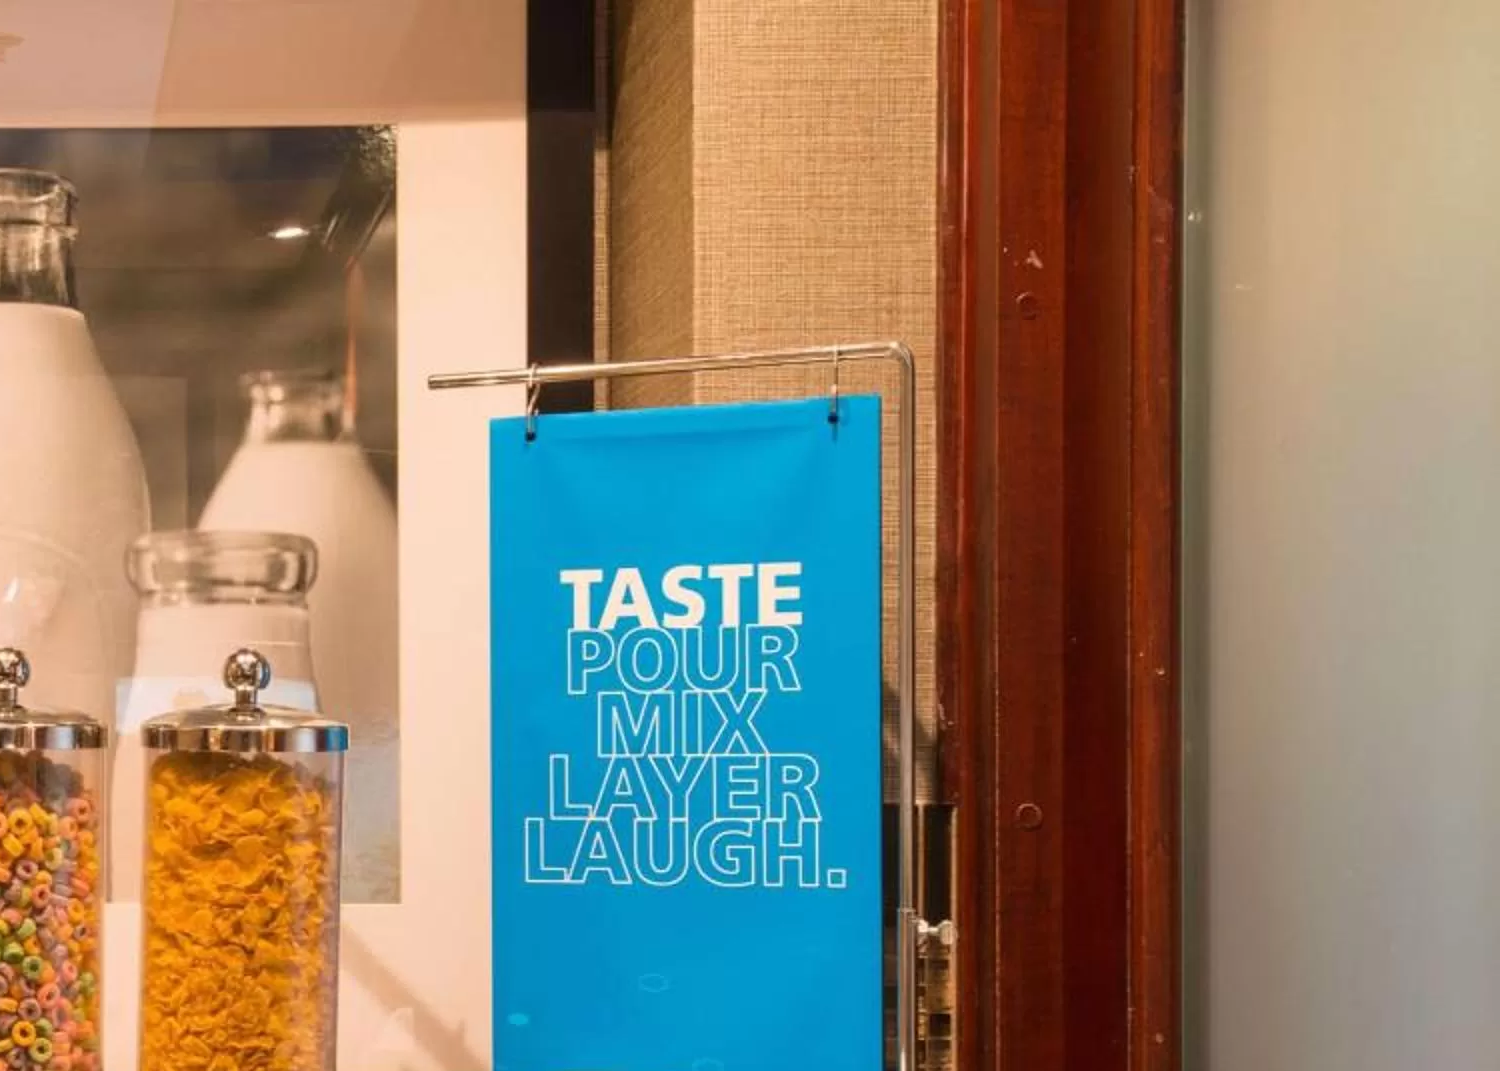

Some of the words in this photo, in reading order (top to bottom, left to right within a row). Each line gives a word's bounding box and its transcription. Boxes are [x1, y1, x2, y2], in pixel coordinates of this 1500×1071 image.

[560, 562, 803, 630] TASTE
[567, 624, 801, 695] POUR
[597, 688, 769, 758] MIX
[549, 754, 822, 821] LAYER
[524, 817, 847, 888] LAUGH.
